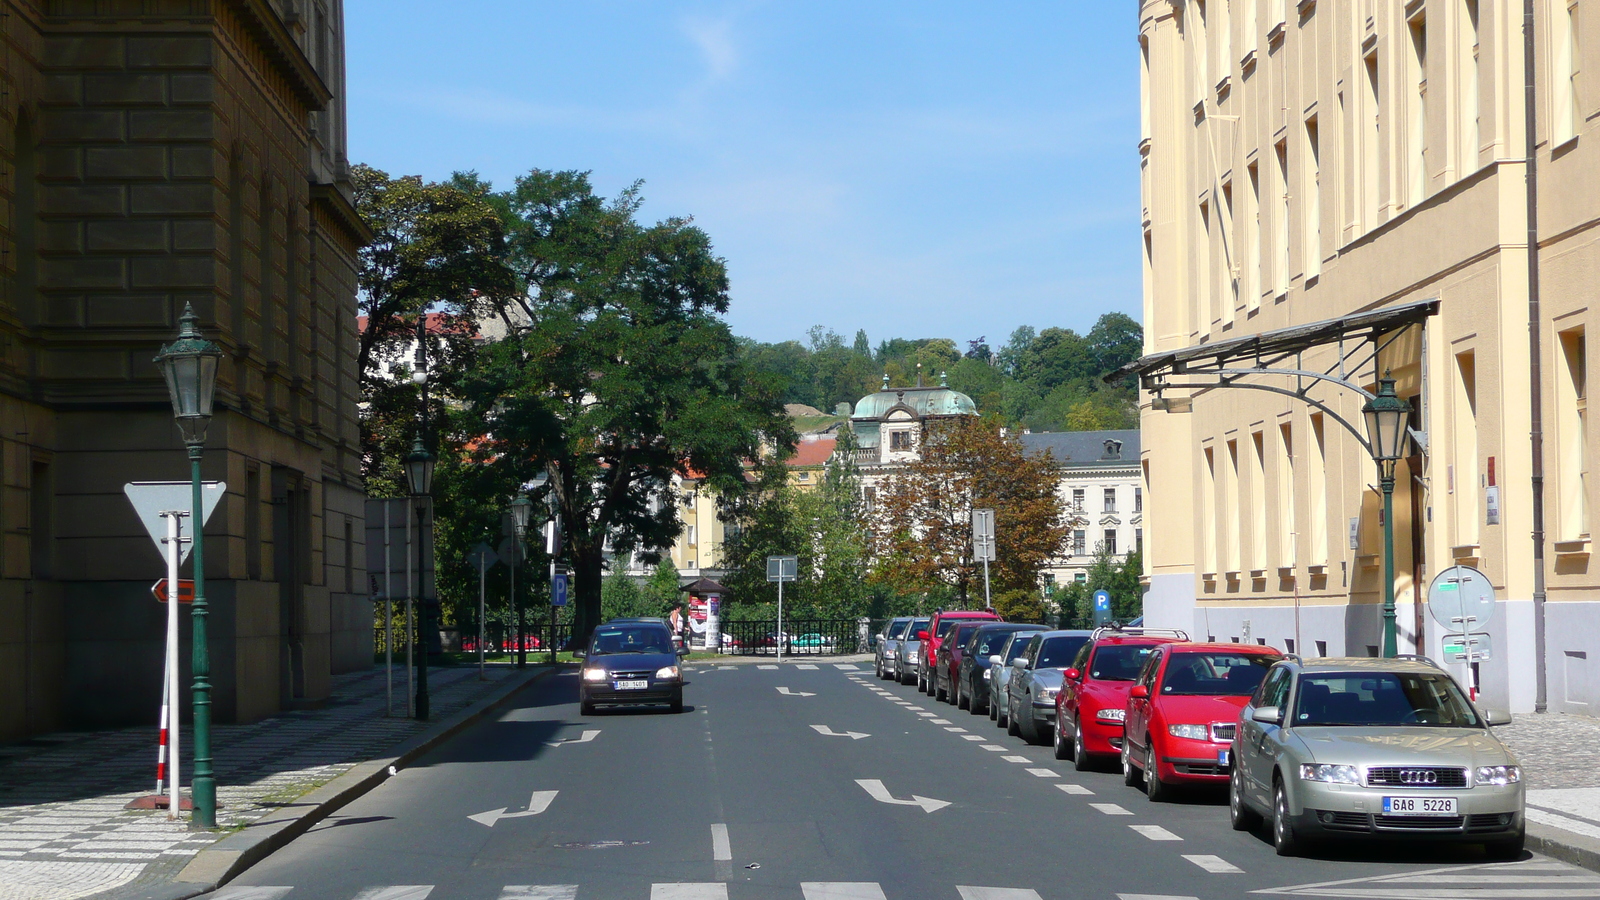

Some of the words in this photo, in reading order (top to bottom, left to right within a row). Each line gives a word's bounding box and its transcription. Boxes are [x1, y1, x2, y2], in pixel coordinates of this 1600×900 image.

[556, 578, 565, 602] P
[1098, 595, 1106, 606] P
[1393, 799, 1415, 811] 6A8
[1423, 799, 1452, 812] 5228
